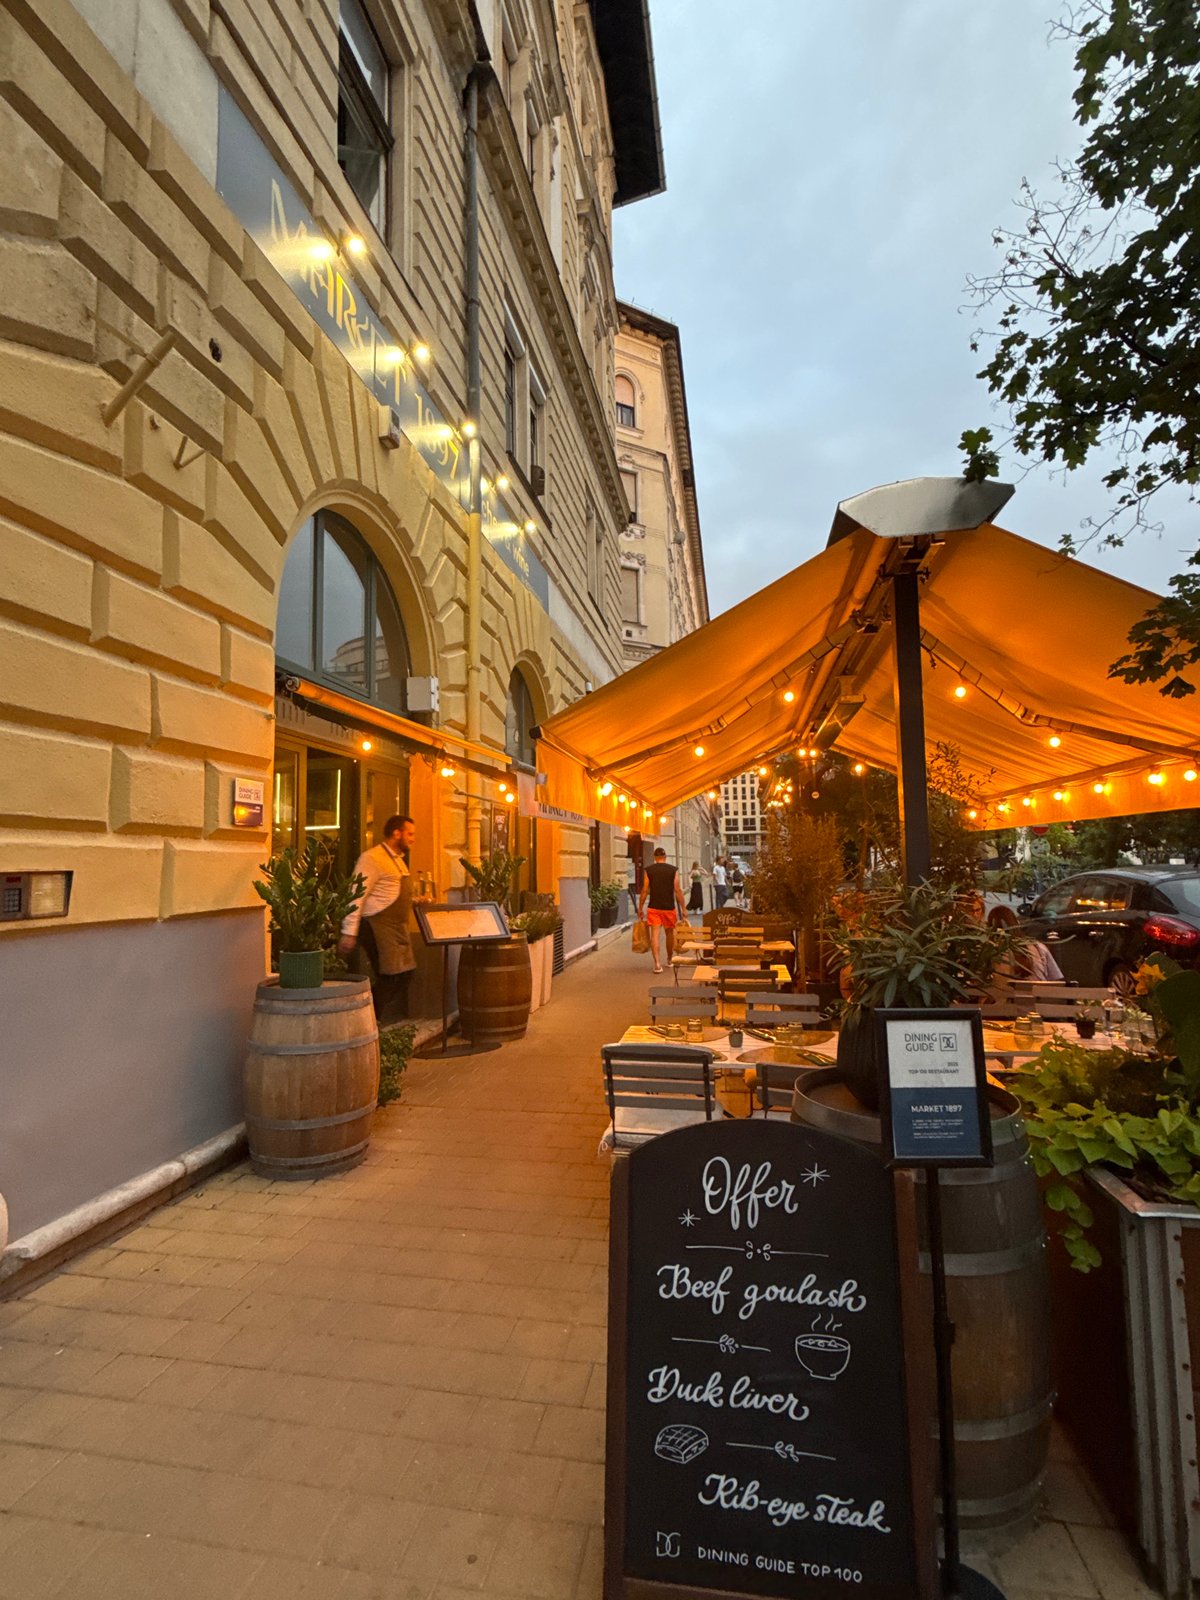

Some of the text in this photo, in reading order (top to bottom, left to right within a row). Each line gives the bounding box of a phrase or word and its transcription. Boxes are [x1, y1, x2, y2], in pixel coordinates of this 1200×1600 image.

[904, 1033, 937, 1042] DINING
[905, 1042, 935, 1052] GUIDE
[945, 1104, 962, 1112] 1897
[703, 1156, 798, 1230] Offer
[657, 1264, 866, 1319] Beef goulash
[647, 1365, 810, 1421] Duck liver
[698, 1474, 891, 1533] Rib-eye steak
[698, 1546, 863, 1583] DINING GUIDE TOP 100
